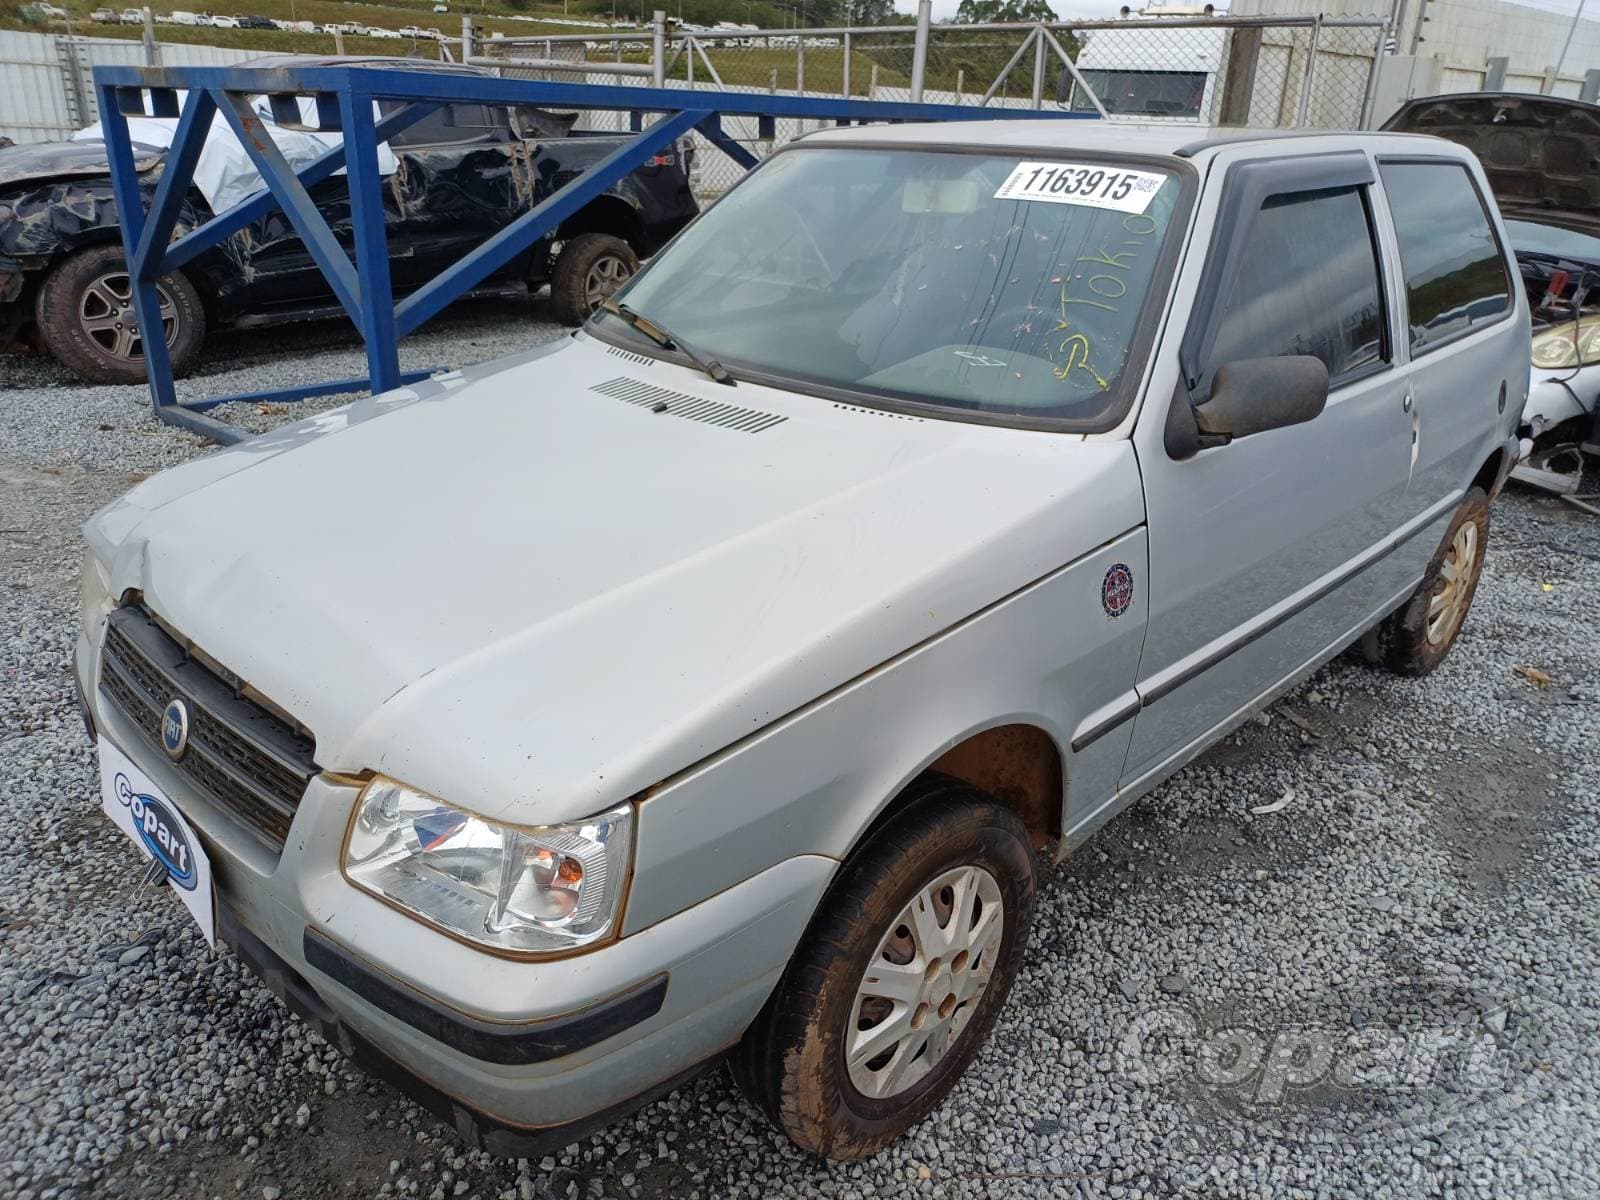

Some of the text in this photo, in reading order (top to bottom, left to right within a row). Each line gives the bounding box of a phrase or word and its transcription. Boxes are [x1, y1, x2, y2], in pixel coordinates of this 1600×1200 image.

[1023, 167, 1138, 201] 1163915
[165, 714, 182, 741] FIAT
[114, 772, 188, 873] Copart
